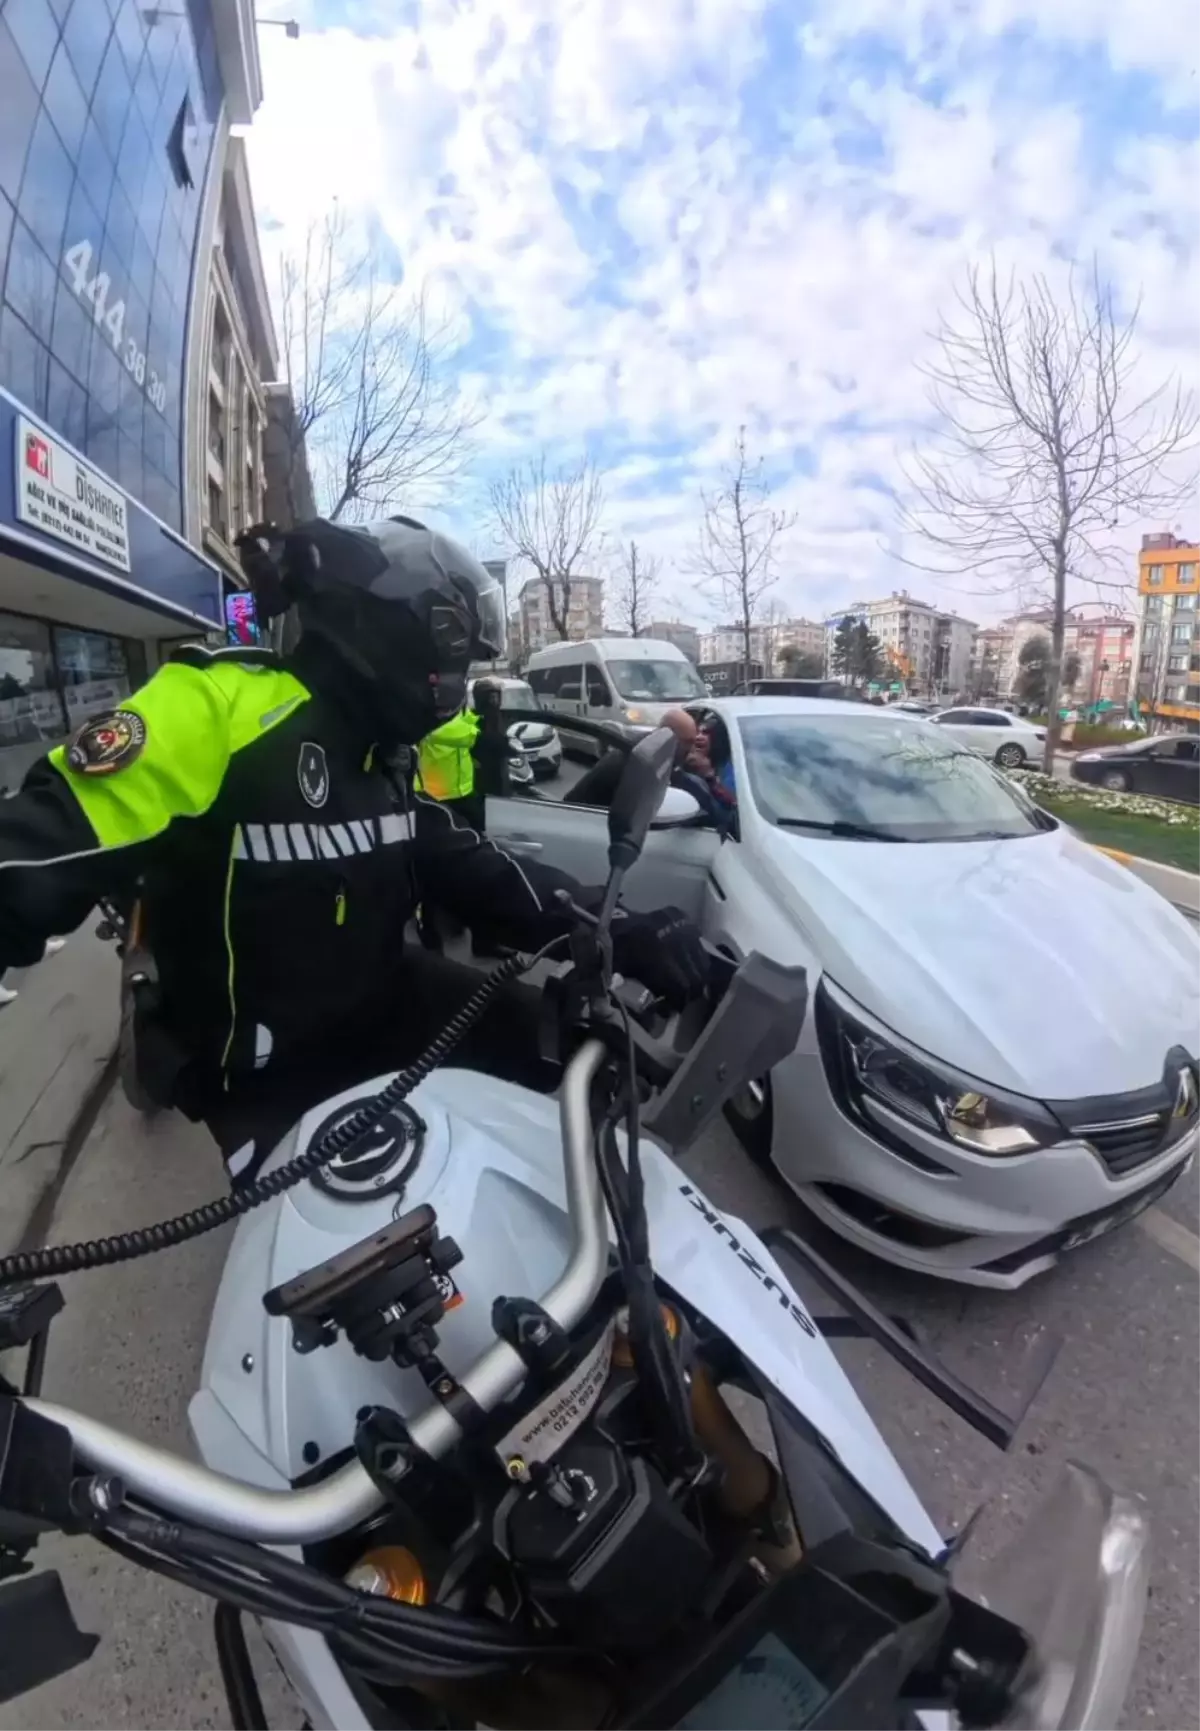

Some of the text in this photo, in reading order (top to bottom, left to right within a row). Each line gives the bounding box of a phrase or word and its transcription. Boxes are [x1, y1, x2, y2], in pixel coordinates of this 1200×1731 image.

[65, 239, 165, 413] 444 38 30
[679, 1185, 817, 1338] SUZUKI
